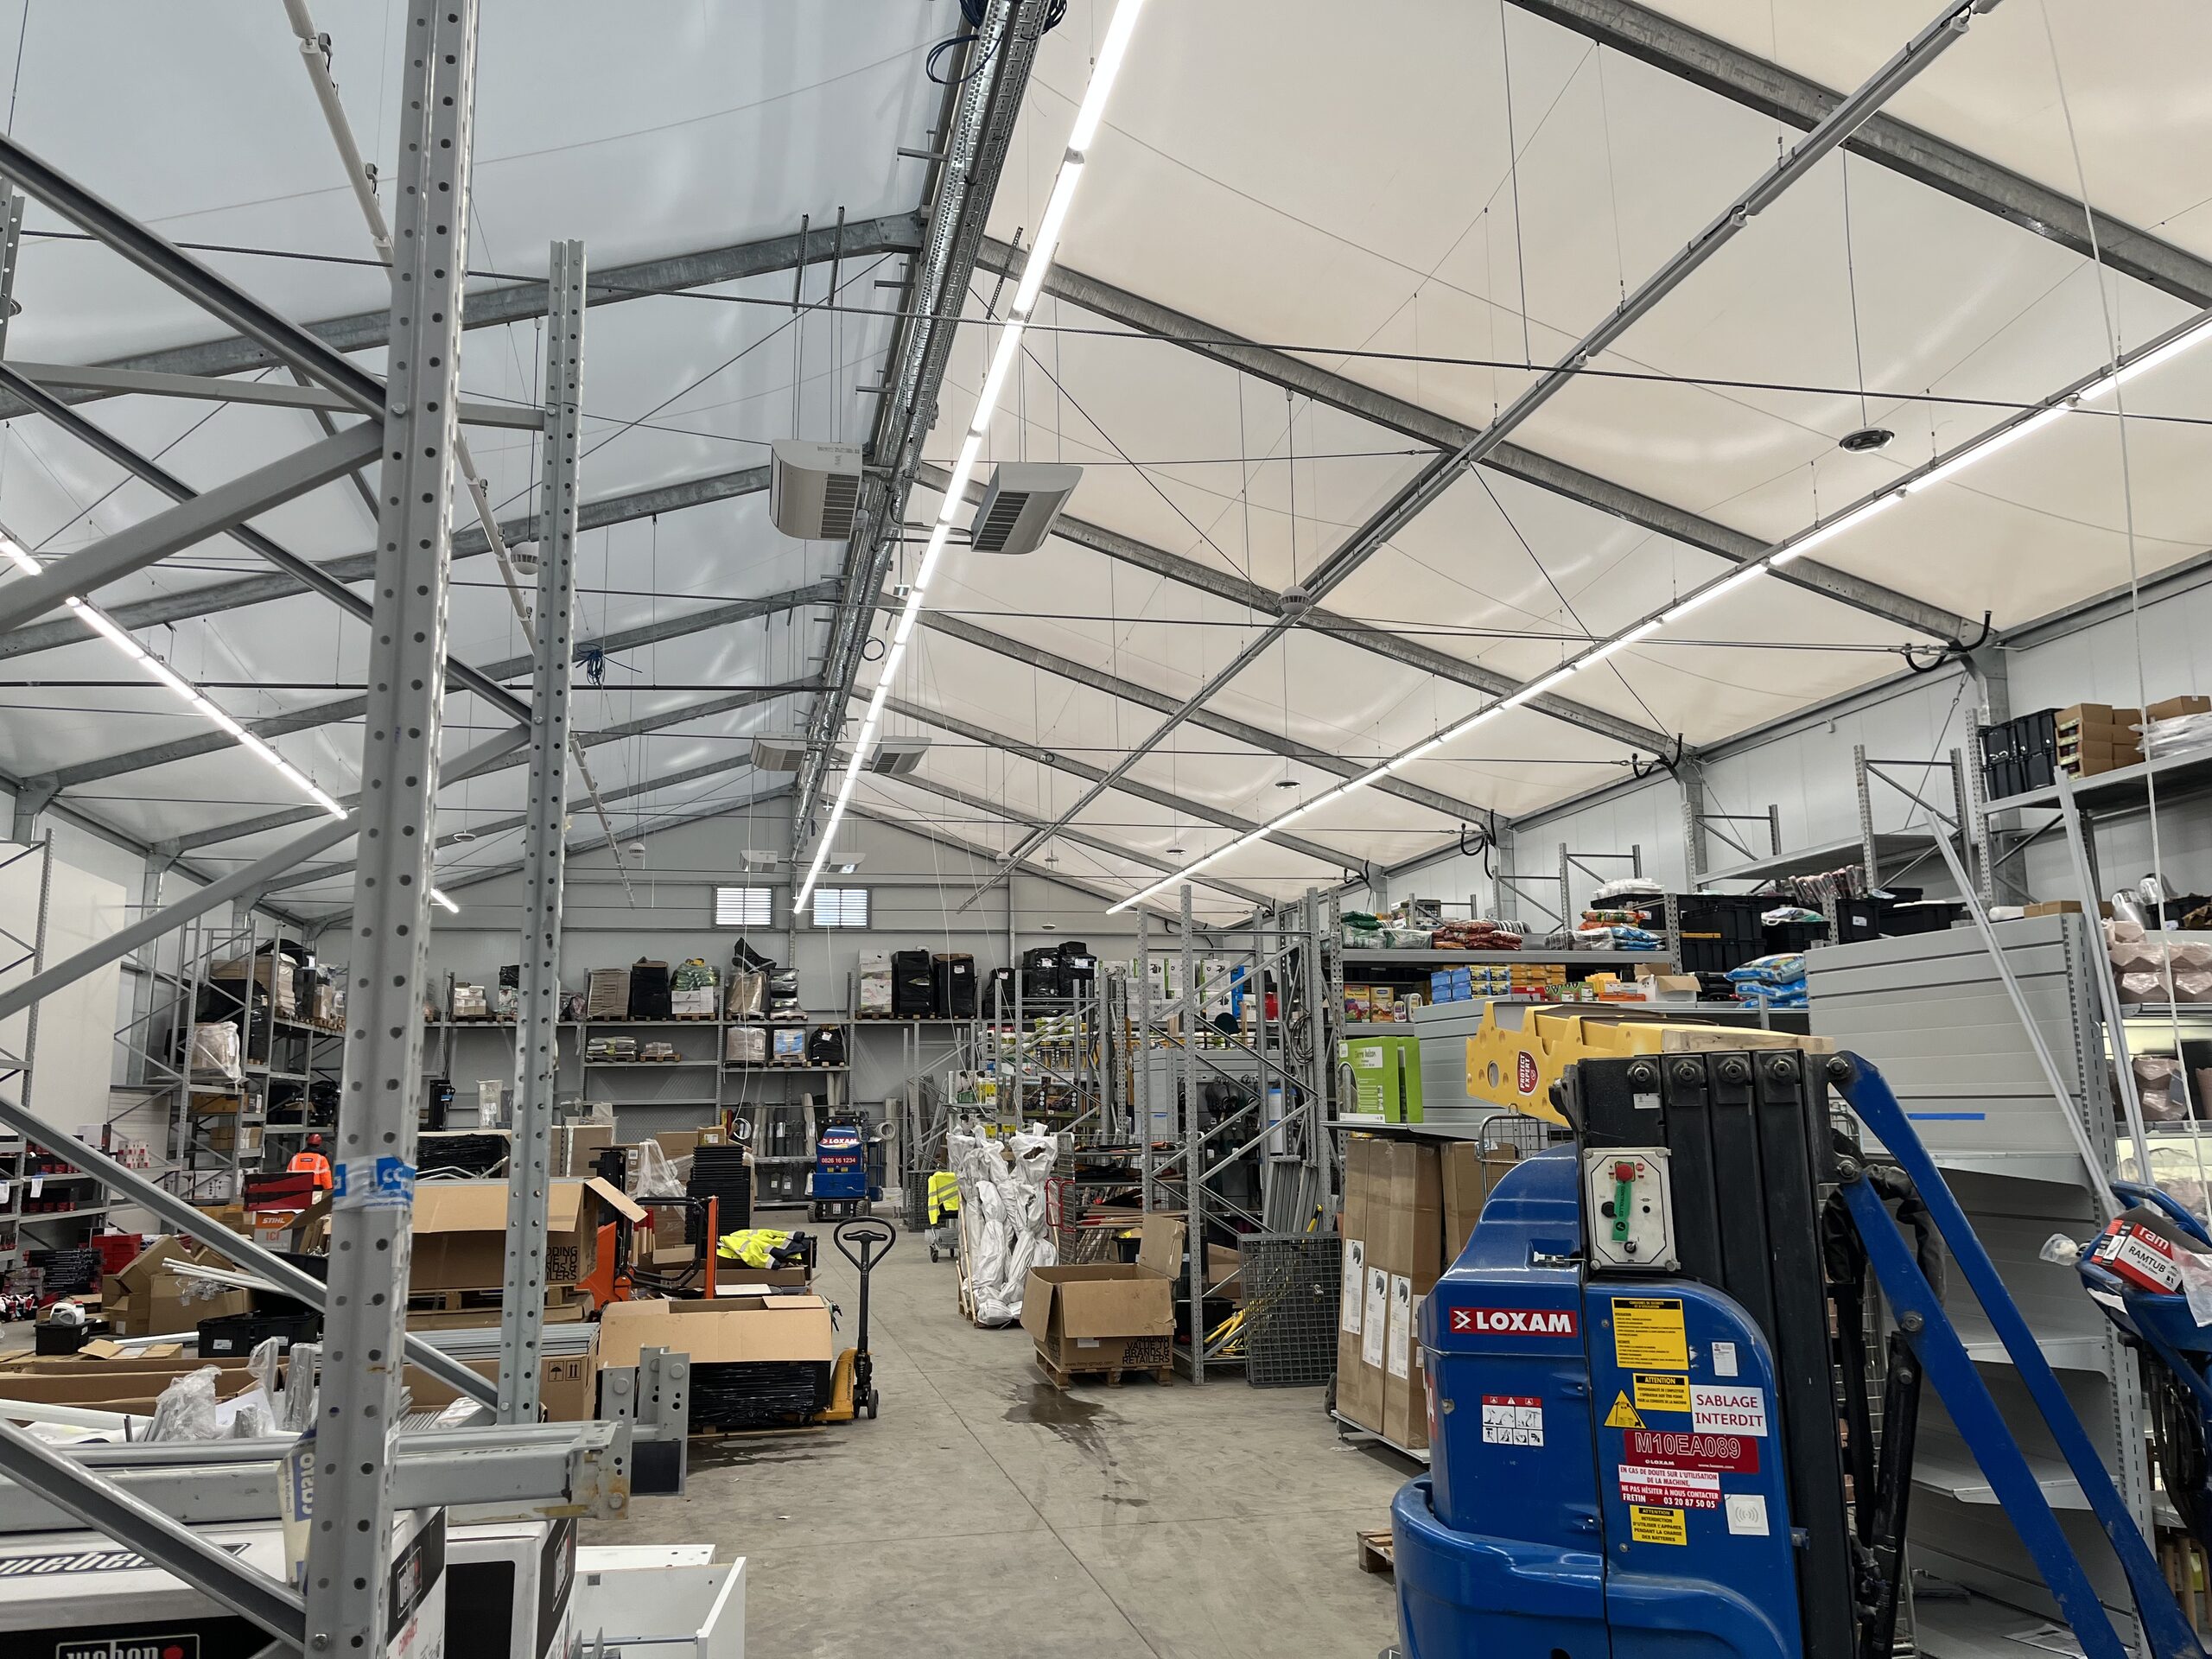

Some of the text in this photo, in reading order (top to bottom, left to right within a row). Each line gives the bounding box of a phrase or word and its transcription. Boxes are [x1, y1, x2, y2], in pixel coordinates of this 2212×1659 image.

[266, 1230, 280, 1241] ICI
[2139, 1226, 2170, 1250] ram
[546, 1246, 578, 1256] DDING
[564, 1254, 578, 1263] TO
[2128, 1246, 2166, 1273] RAMTUB
[1476, 1311, 1572, 1333] LOXAM
[1126, 1340, 1170, 1350] VALUE TO
[1125, 1348, 1160, 1357] BRANDS
[1122, 1355, 1170, 1364] RETAILERS
[1696, 1394, 1758, 1408] SABLAGE
[1694, 1412, 1764, 1427] INTERDIT
[1635, 1432, 1741, 1459] M10EA089
[1679, 1471, 1717, 1480] L'UTILISATION
[1623, 1493, 1646, 1503] FRETIN
[1687, 1491, 1719, 1500] CONTACTER
[0, 1552, 145, 1576] weber
